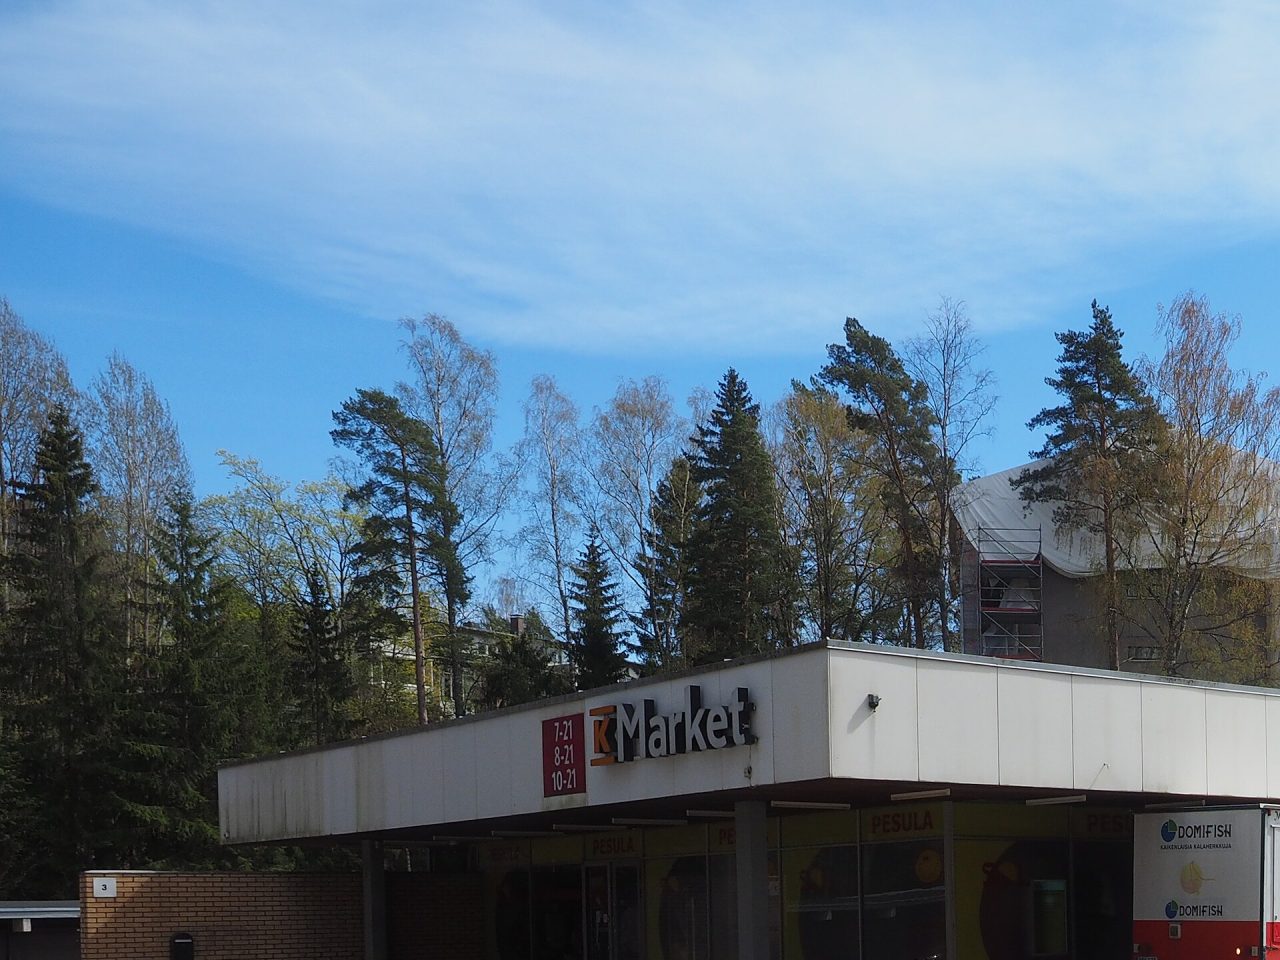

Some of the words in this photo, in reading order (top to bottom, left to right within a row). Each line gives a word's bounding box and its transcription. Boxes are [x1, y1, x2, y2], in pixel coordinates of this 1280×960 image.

[554, 719, 573, 742] 7-21
[615, 685, 750, 763] Market
[554, 745, 575, 767] 8-21
[551, 769, 577, 791] 10-21
[870, 810, 934, 834] PESULA
[1178, 824, 1232, 838] DOMIFISH
[592, 837, 634, 856] PESULA
[1179, 904, 1223, 917] DOMIFISH
